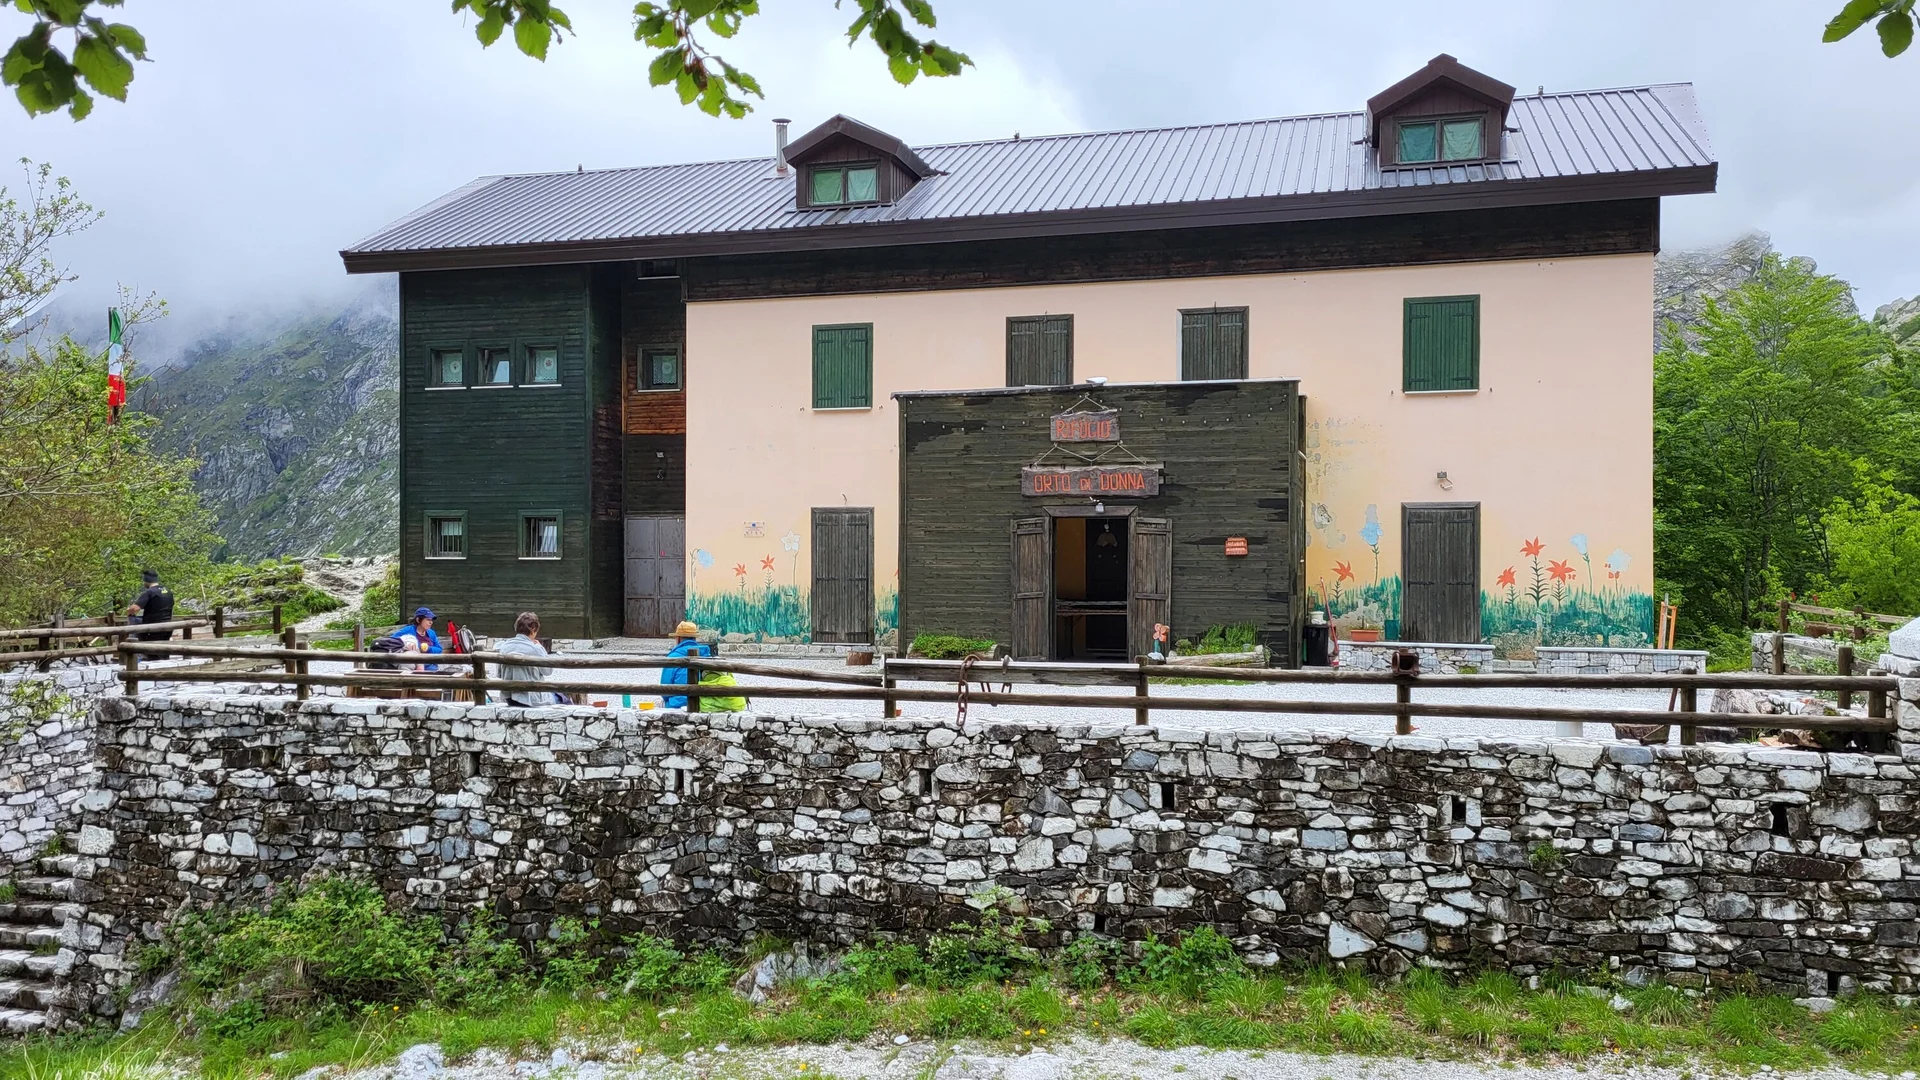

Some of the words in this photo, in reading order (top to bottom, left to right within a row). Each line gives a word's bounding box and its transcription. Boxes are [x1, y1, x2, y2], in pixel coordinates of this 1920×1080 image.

[1055, 419, 1111, 439] RIFUGIO
[1033, 473, 1071, 493] ORTO
[1099, 472, 1146, 491] DONNA
